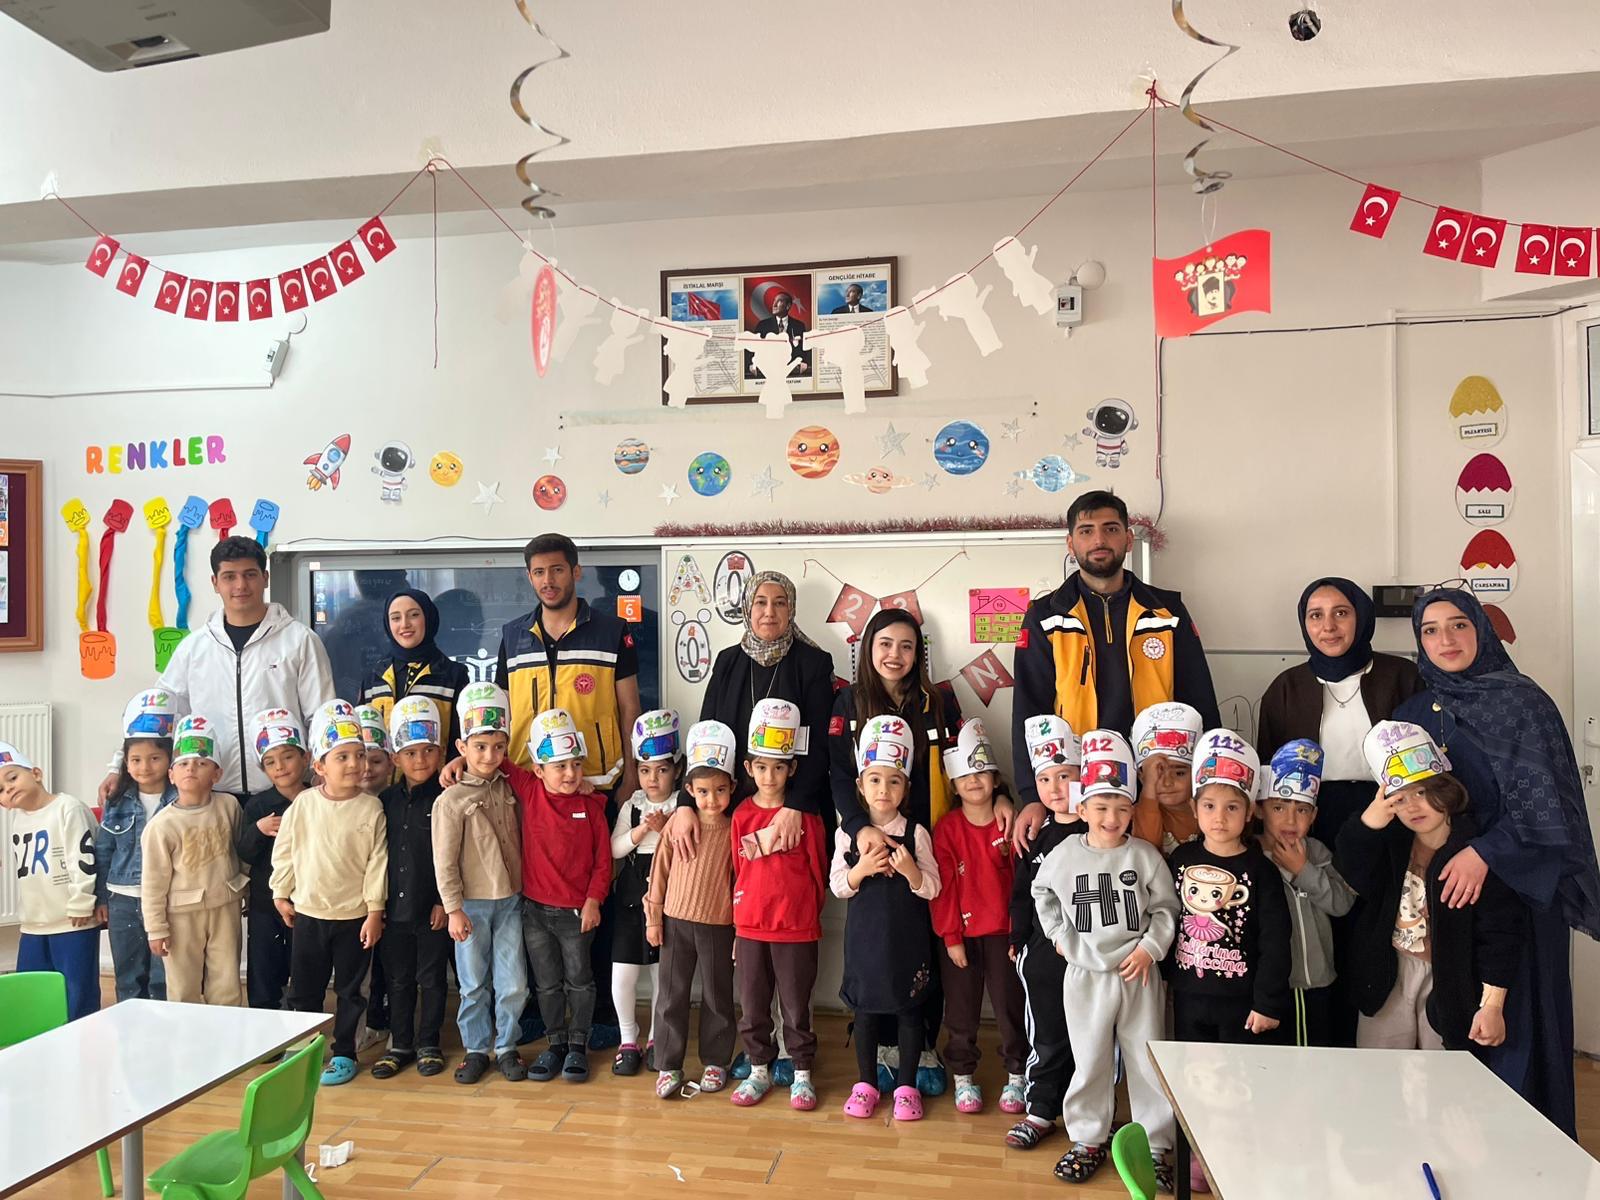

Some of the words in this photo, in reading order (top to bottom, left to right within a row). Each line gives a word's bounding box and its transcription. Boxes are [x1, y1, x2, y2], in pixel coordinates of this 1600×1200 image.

[86, 435, 226, 475] RENKLER
[625, 603, 634, 616] 6
[141, 692, 169, 707] 112
[467, 684, 497, 702] 112
[644, 712, 673, 730] 112
[872, 719, 905, 736] 112
[1208, 734, 1246, 755] 112
[1377, 723, 1420, 748] 112
[1082, 738, 1115, 756] 112
[1071, 869, 1140, 933] Hi
